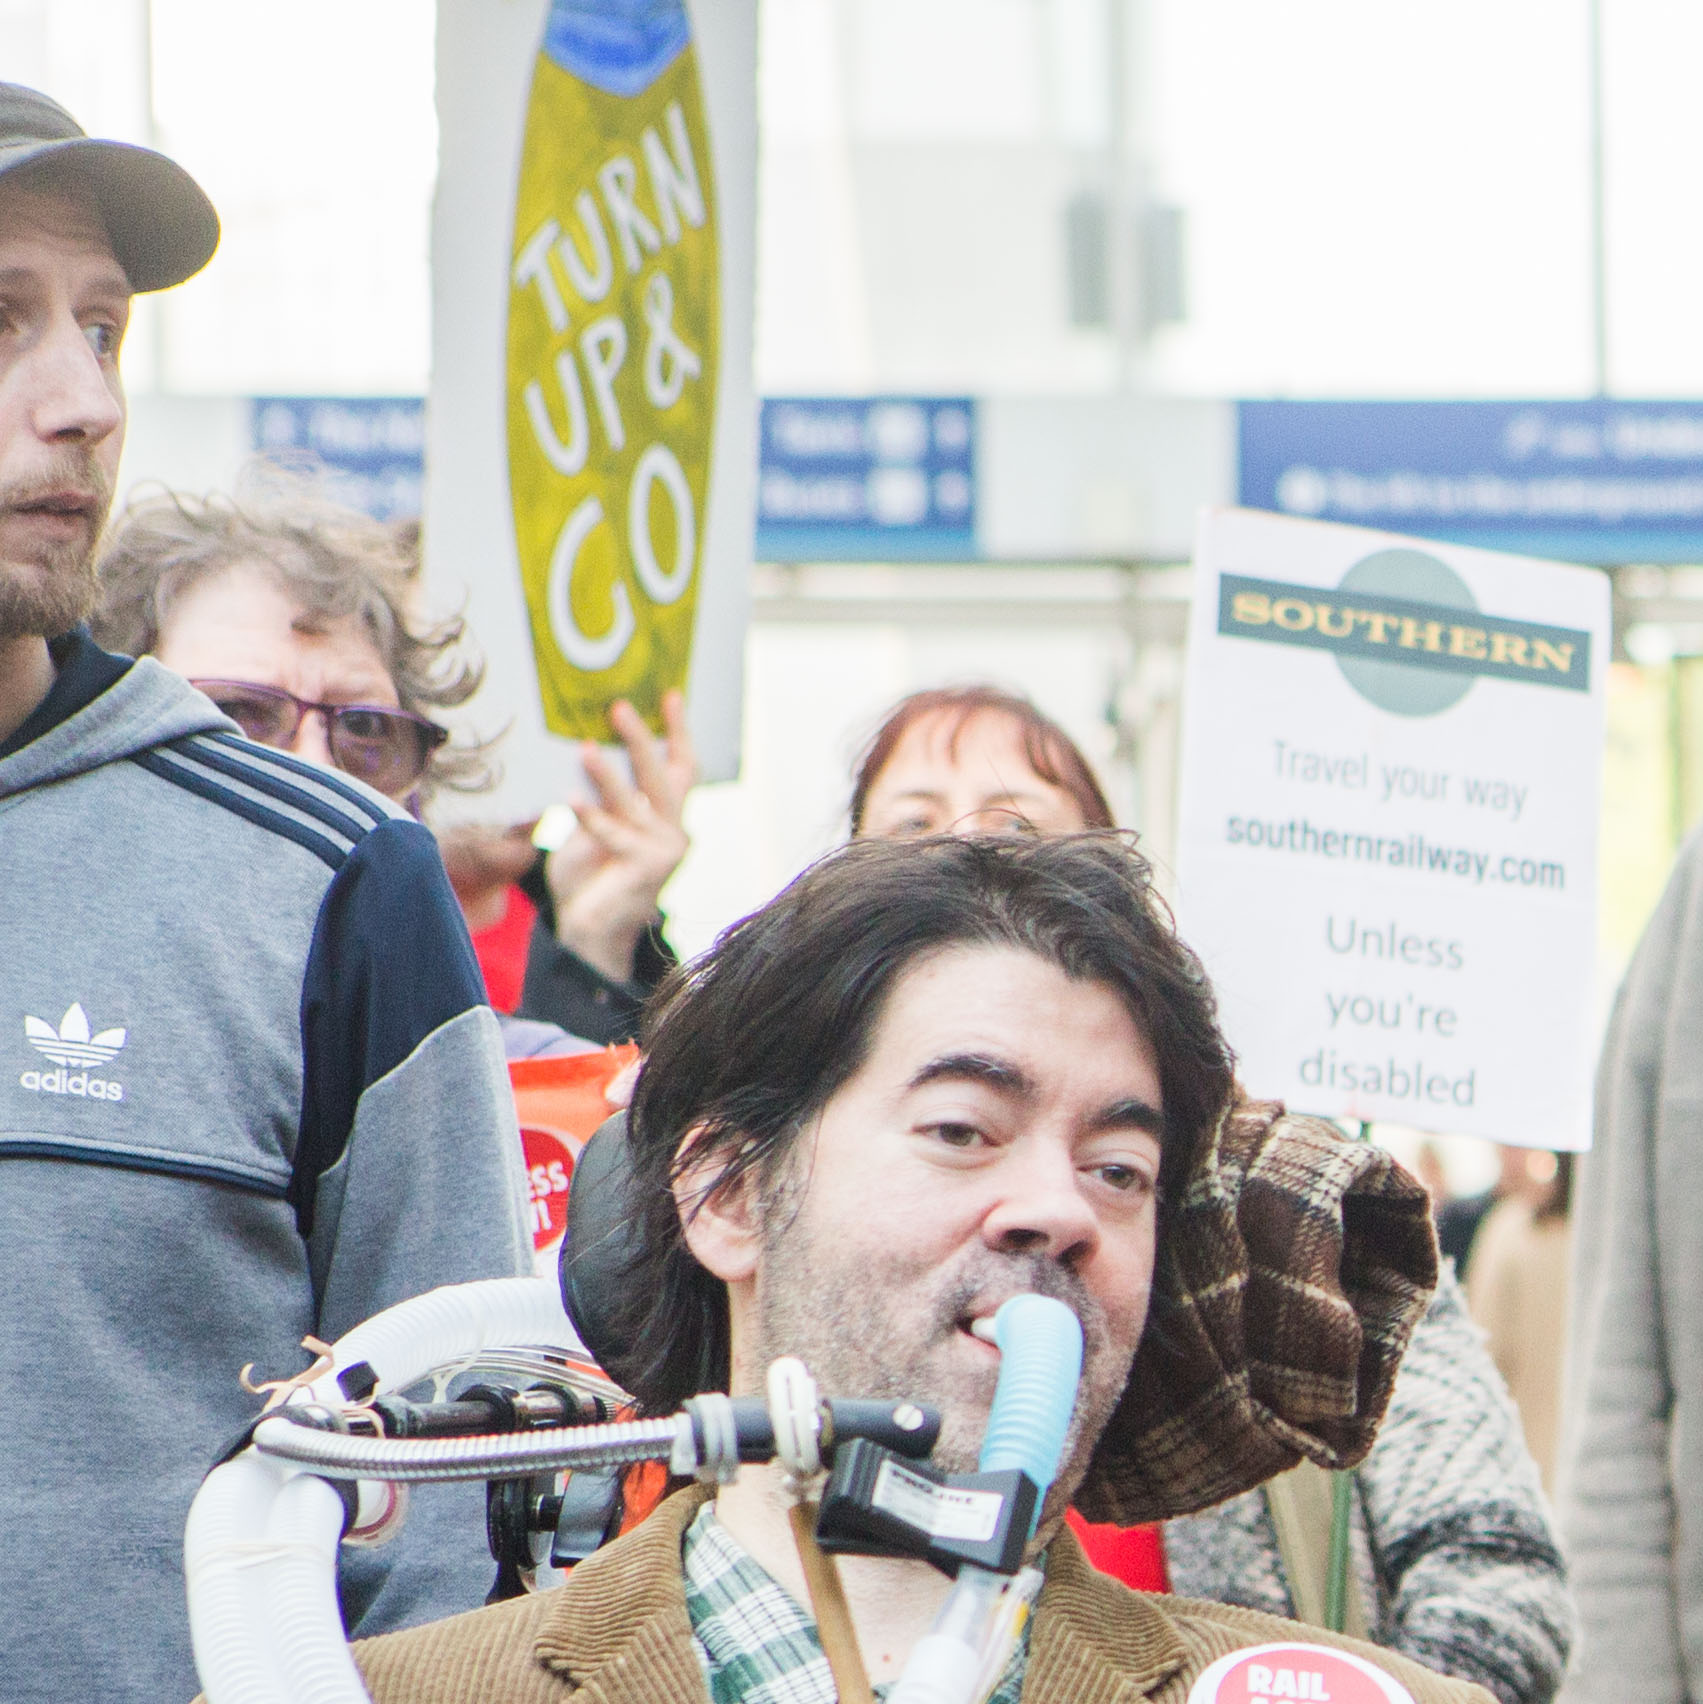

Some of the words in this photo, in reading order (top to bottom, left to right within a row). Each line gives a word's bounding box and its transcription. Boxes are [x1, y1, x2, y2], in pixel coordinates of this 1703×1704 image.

[514, 101, 706, 334] TURN
[524, 315, 627, 477] UP
[645, 269, 700, 410] &
[547, 442, 696, 672] GO
[1231, 590, 1577, 676] SOUTHERN
[1273, 740, 1370, 789] Travel
[1379, 764, 1453, 812] your
[1464, 777, 1529, 821] way
[1225, 812, 1567, 892] southernrailway.com
[1325, 916, 1465, 973] Unless
[1325, 989, 1458, 1040] you're
[19, 1068, 123, 1102] adidas
[1298, 1049, 1478, 1109] disabled
[1246, 1664, 1331, 1702] RAIL
